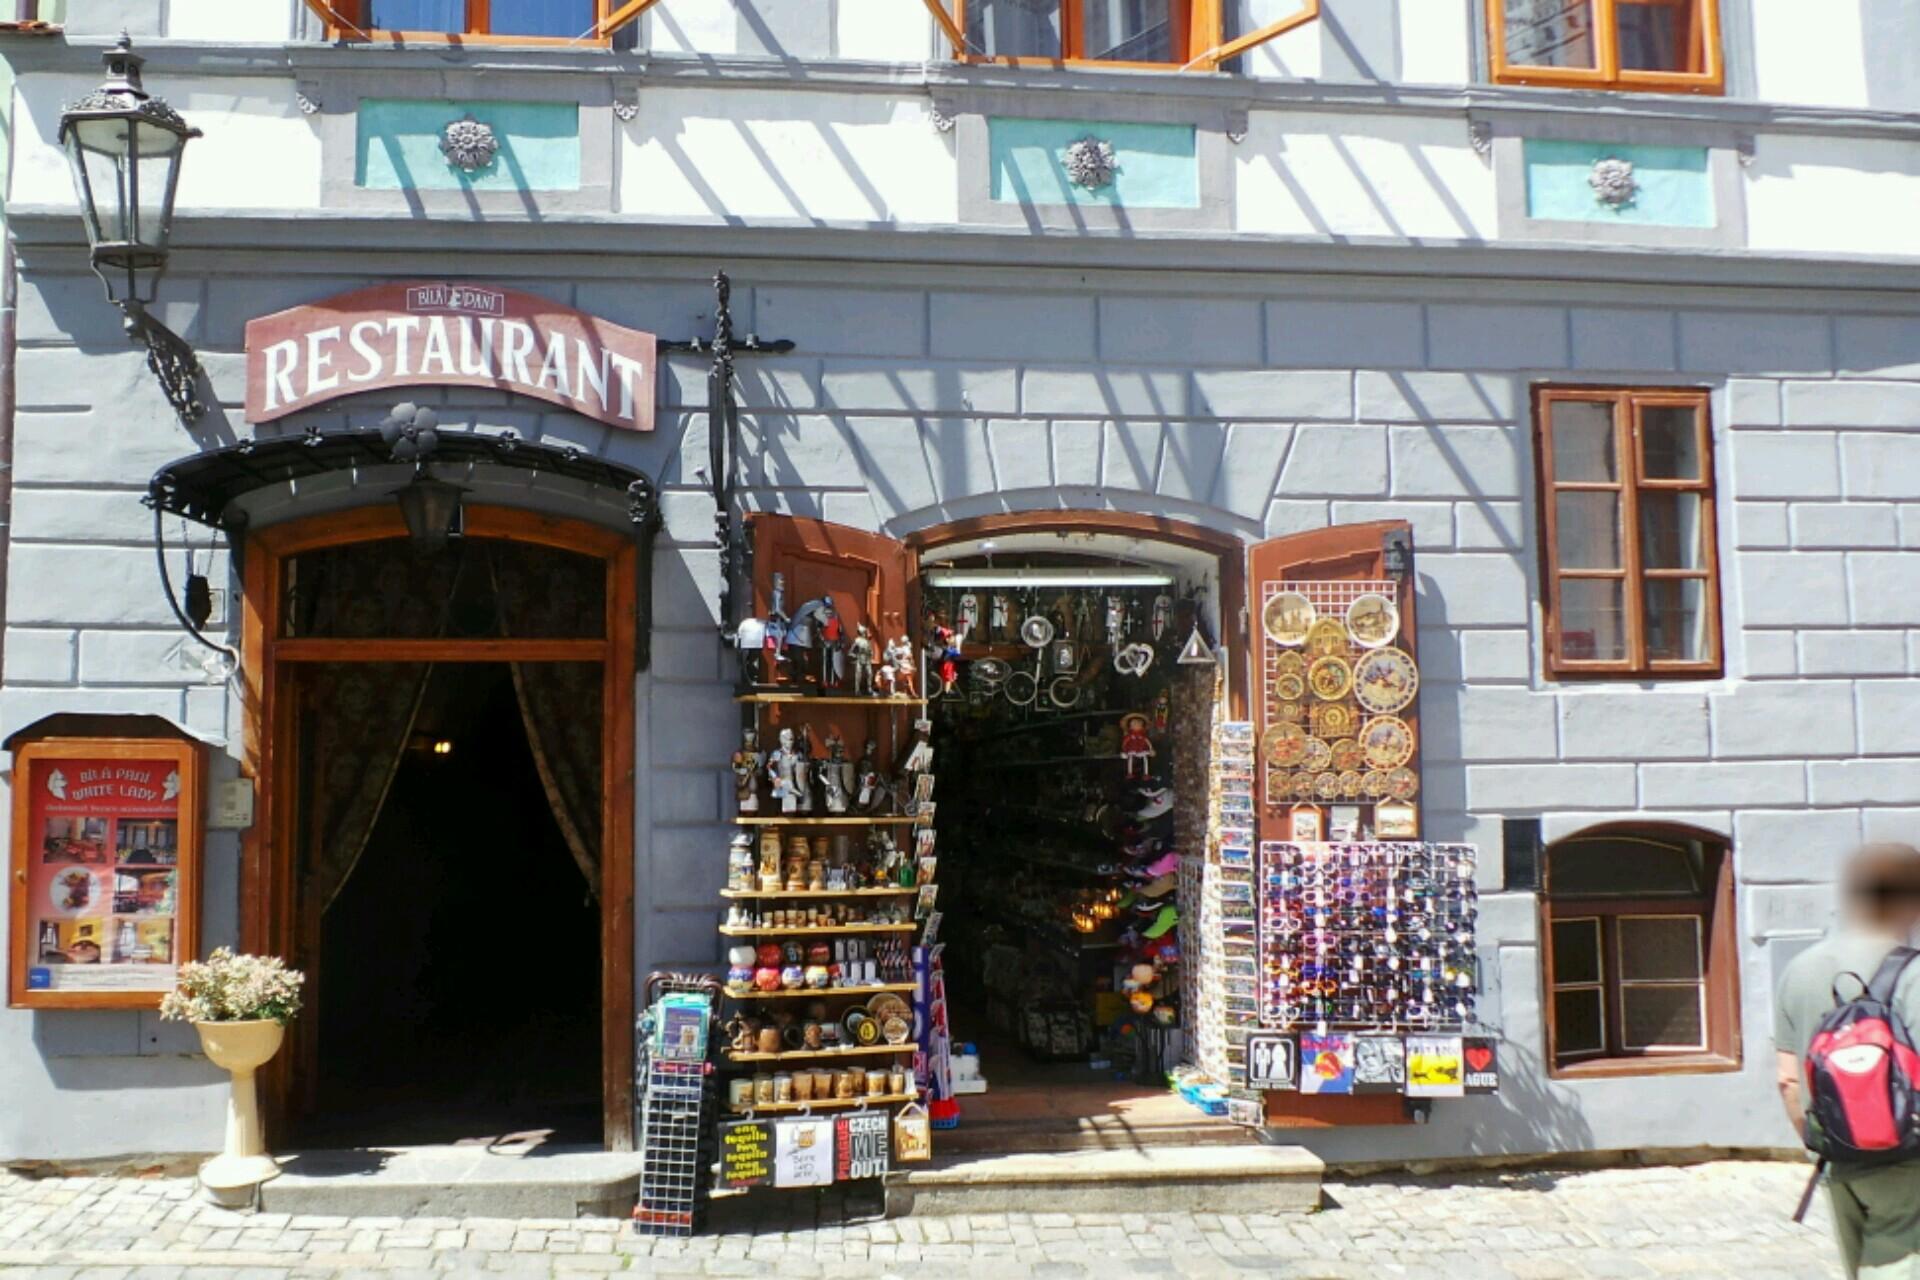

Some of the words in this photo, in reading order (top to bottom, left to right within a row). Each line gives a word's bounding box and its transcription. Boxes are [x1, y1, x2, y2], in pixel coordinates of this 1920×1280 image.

[262, 316, 642, 420] RESTAURANT
[72, 785, 113, 800] WHITE
[120, 784, 156, 800] LADY
[849, 1116, 887, 1132] CZECH
[724, 1130, 768, 1145] tequila
[850, 1132, 887, 1159] ME
[725, 1149, 768, 1164] tequila
[725, 1166, 768, 1181] tequila
